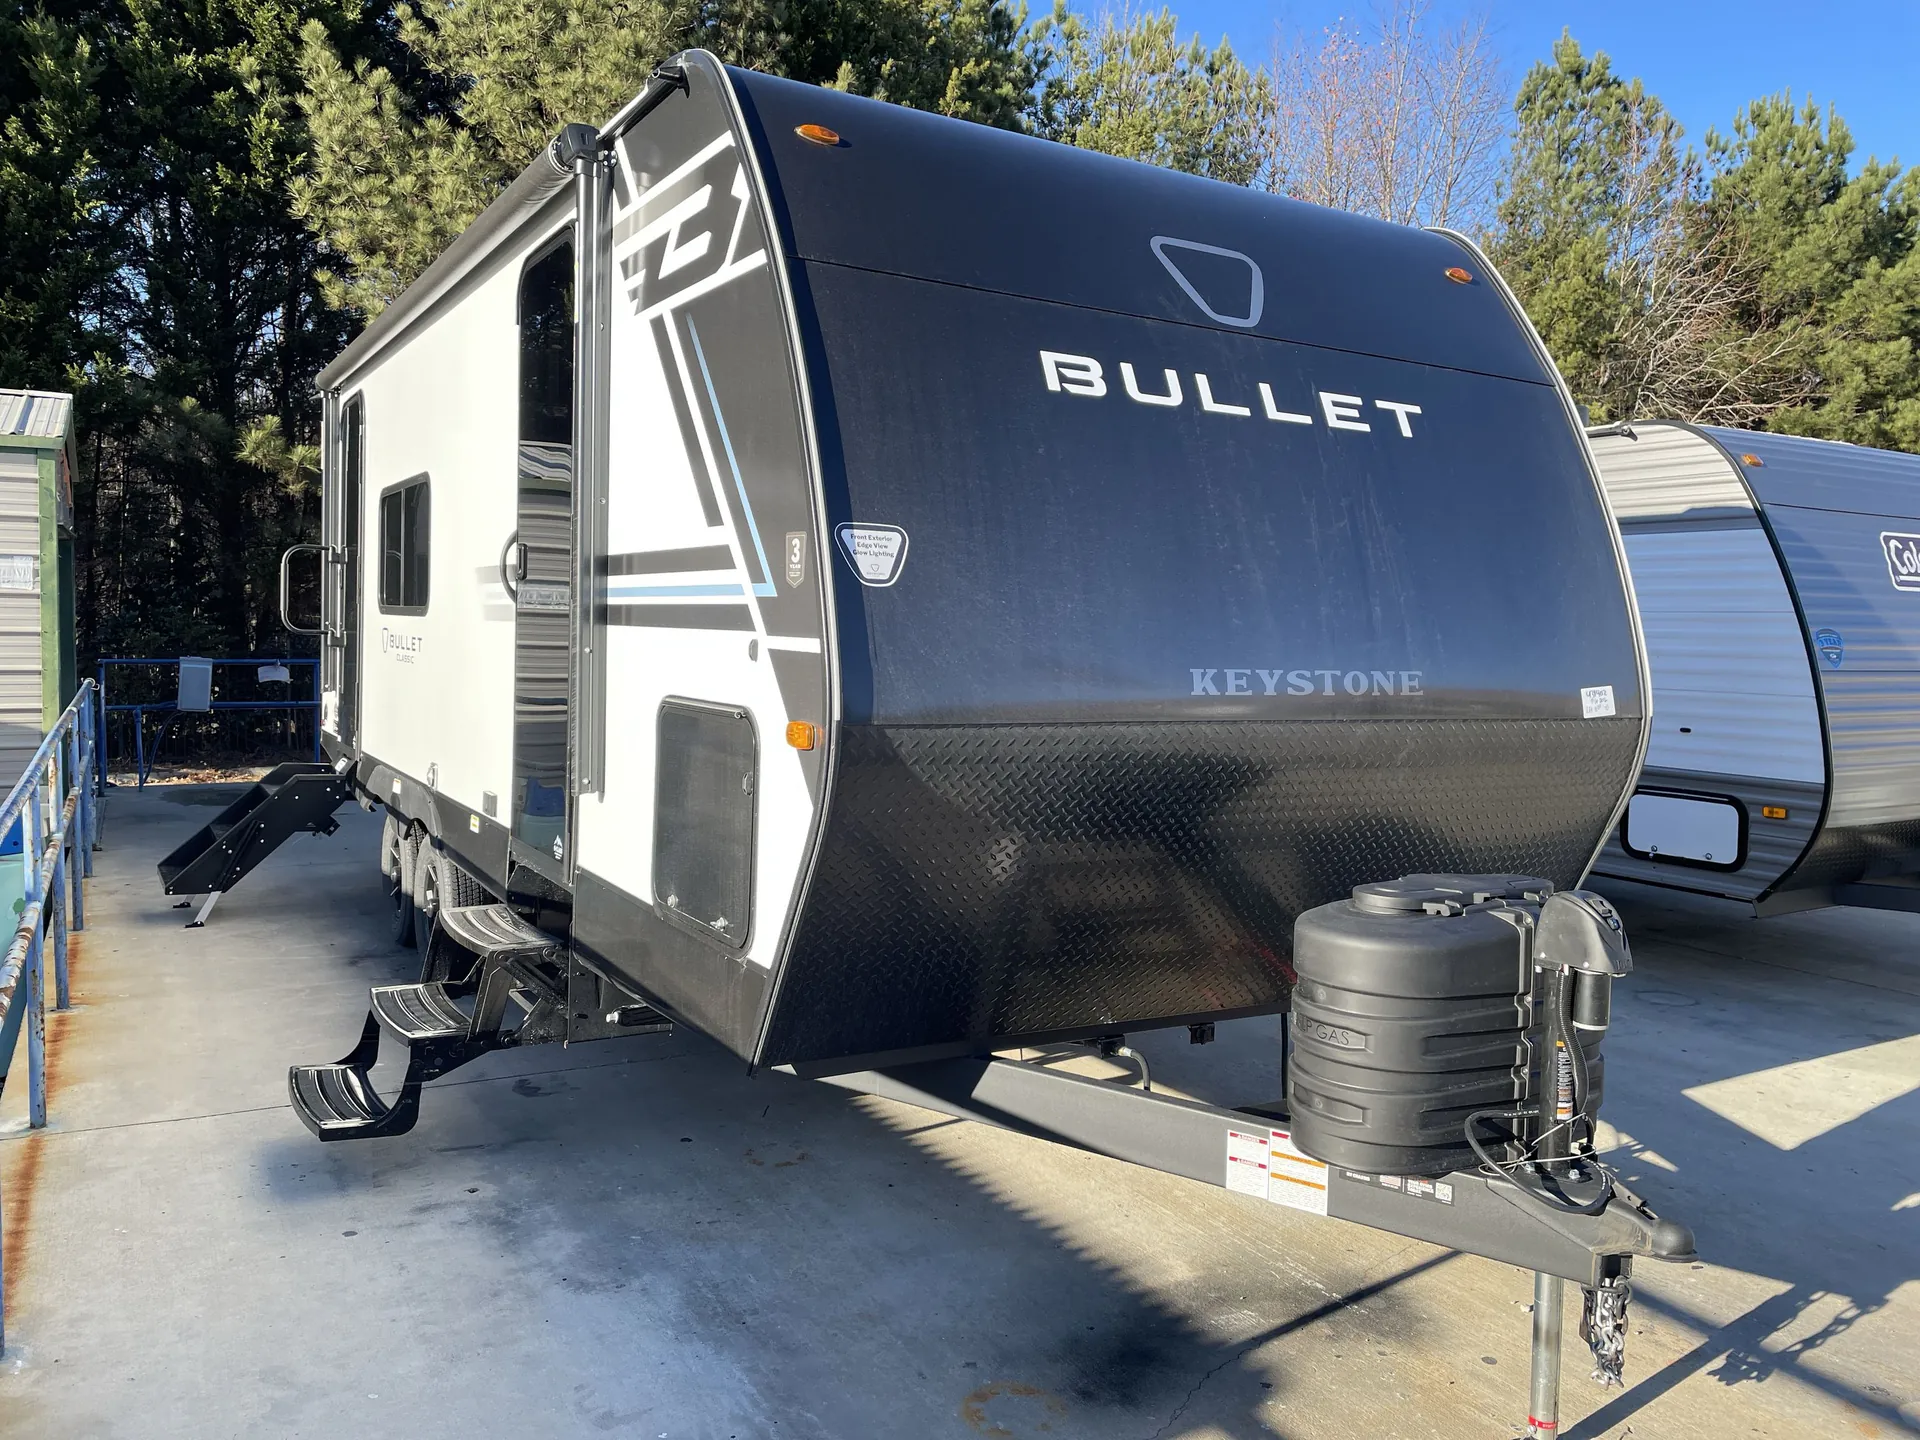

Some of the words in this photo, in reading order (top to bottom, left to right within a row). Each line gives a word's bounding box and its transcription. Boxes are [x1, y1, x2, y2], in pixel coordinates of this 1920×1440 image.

[1039, 350, 1422, 438] BULLET
[791, 537, 801, 563] 3
[868, 534, 893, 542] Exterior
[869, 550, 895, 558] Lighting
[1889, 539, 1920, 574] Col
[390, 634, 423, 653] BULLET
[1190, 668, 1424, 696] KEYSTONE
[1316, 1024, 1349, 1046] GAS
